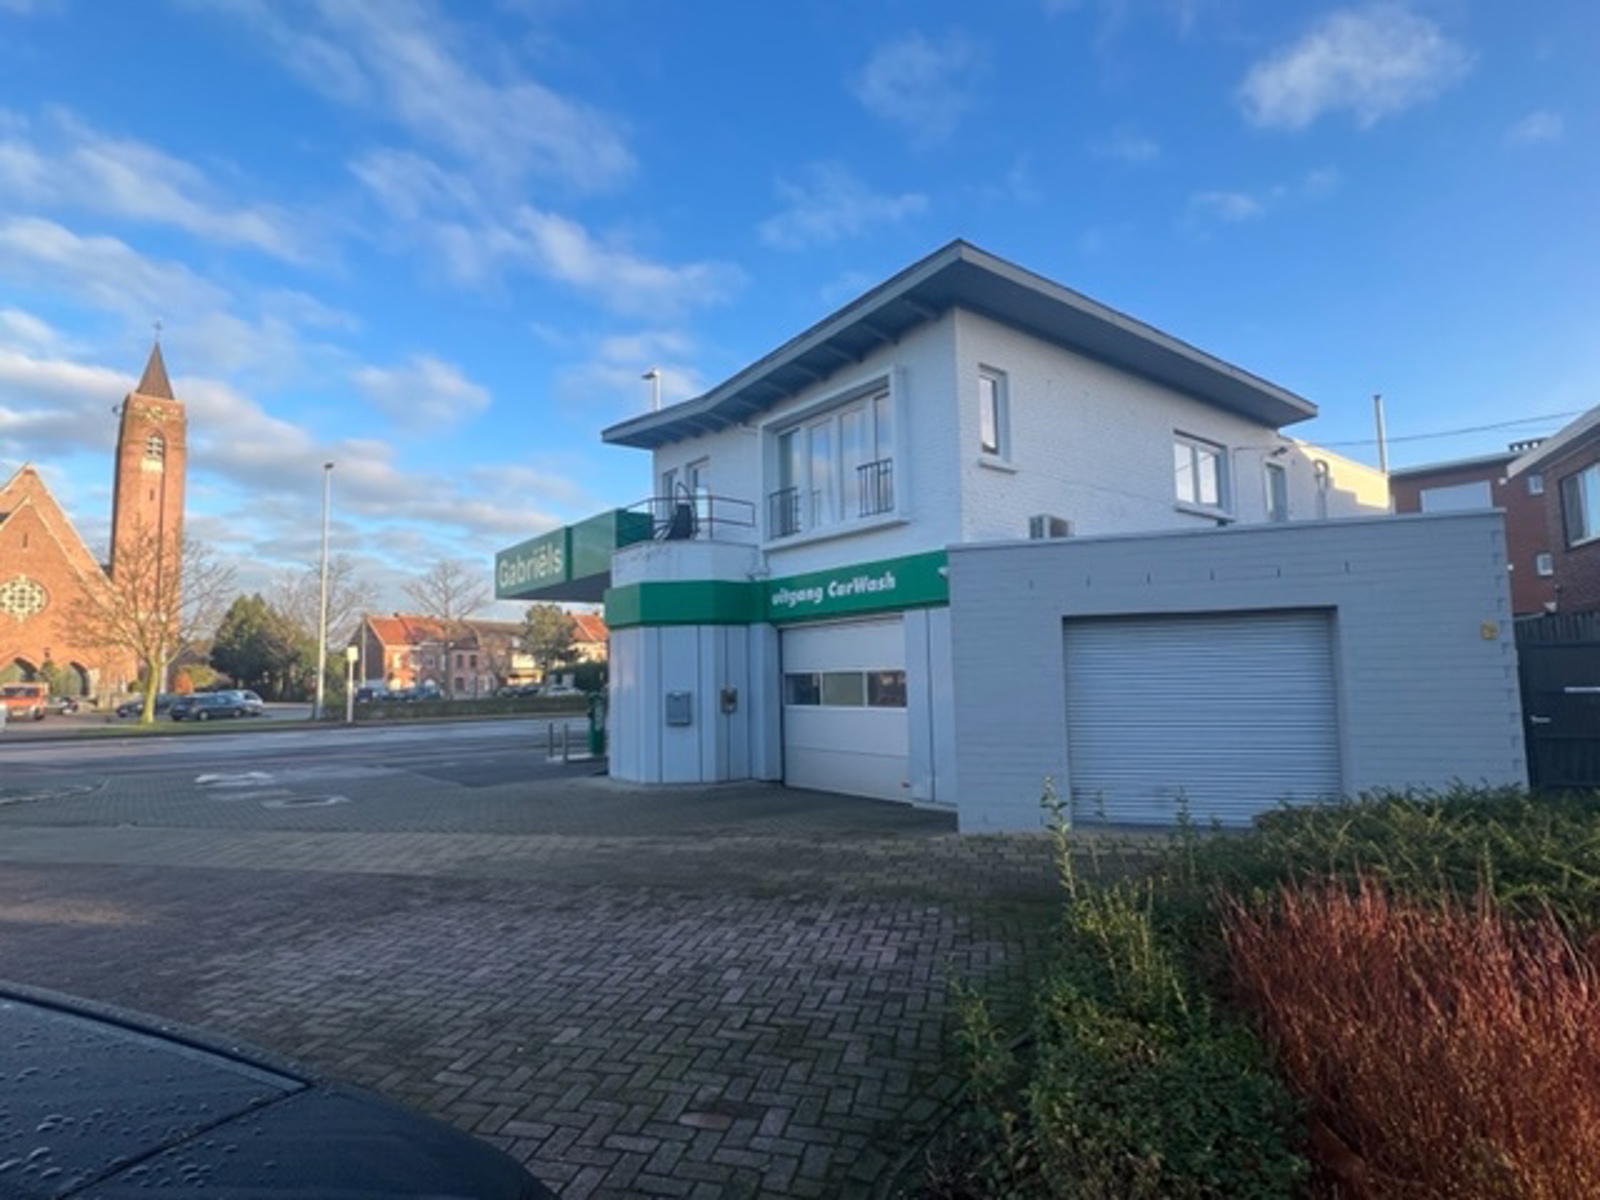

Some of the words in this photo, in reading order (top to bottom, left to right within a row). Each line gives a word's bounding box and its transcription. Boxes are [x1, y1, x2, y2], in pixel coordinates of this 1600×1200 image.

[499, 543, 561, 587] Gabriëls
[772, 586, 823, 607] uitgang
[828, 572, 896, 598] CarWash
